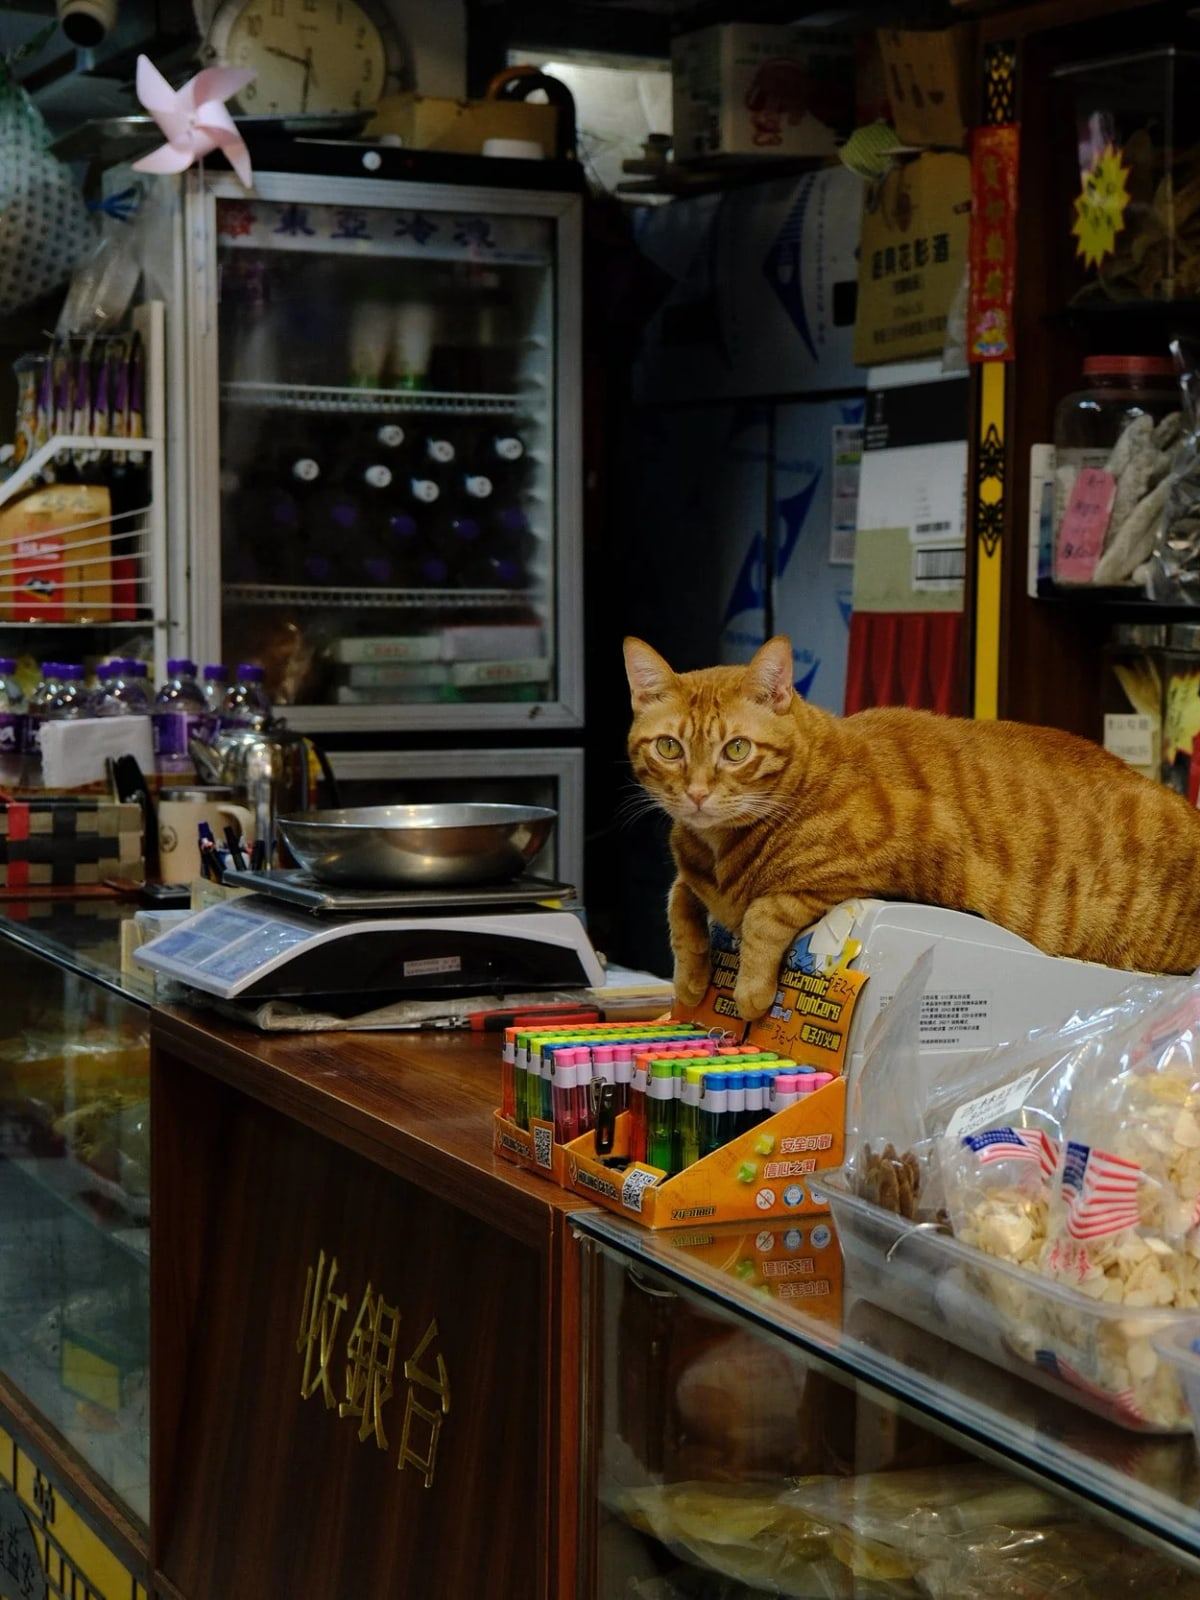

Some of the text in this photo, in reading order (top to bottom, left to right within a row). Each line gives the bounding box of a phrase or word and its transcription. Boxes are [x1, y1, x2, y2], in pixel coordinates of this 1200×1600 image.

[796, 993, 842, 1022] lighters
[781, 1133, 832, 1154] 安全可靠
[295, 1249, 452, 1488] 收銀台
